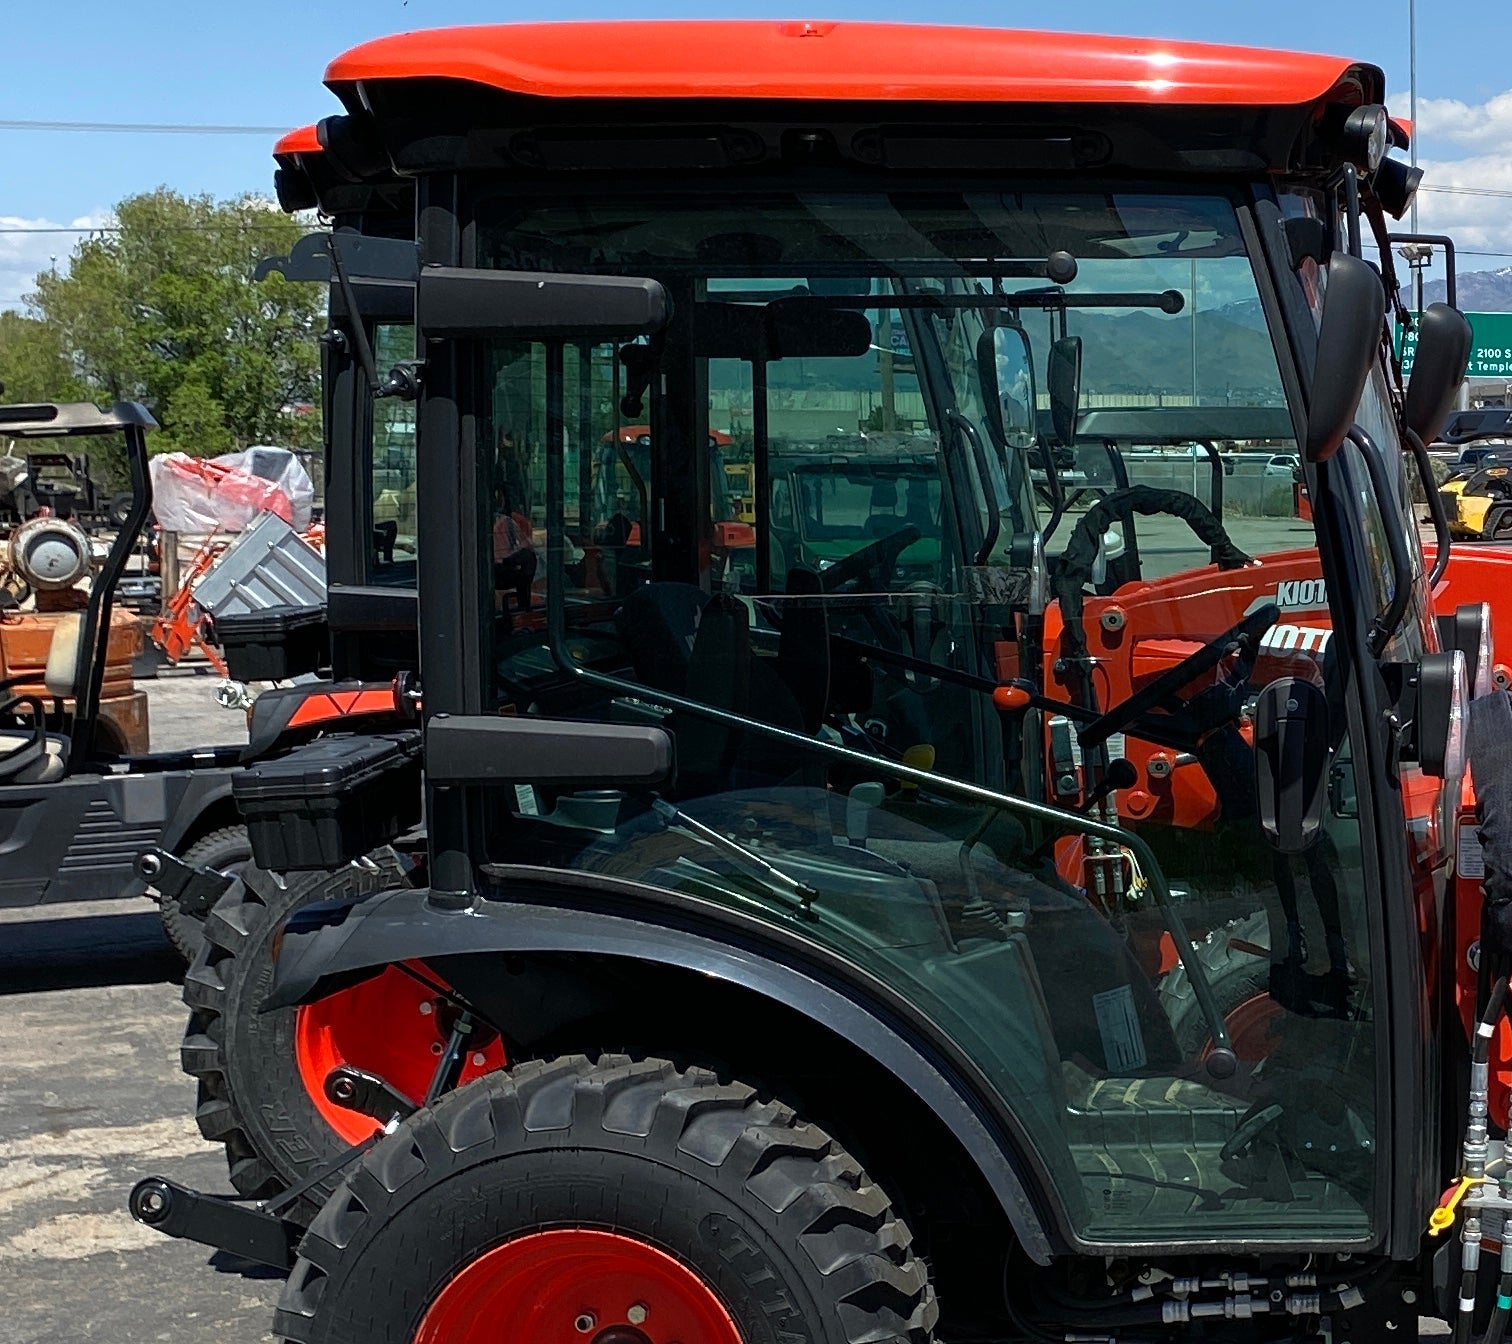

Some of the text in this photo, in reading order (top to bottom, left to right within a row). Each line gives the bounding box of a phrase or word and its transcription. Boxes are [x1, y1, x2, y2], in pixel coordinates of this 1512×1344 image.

[1477, 349, 1502, 358] 2100
[1505, 349, 1512, 358] S
[1277, 578, 1328, 606] KIOT
